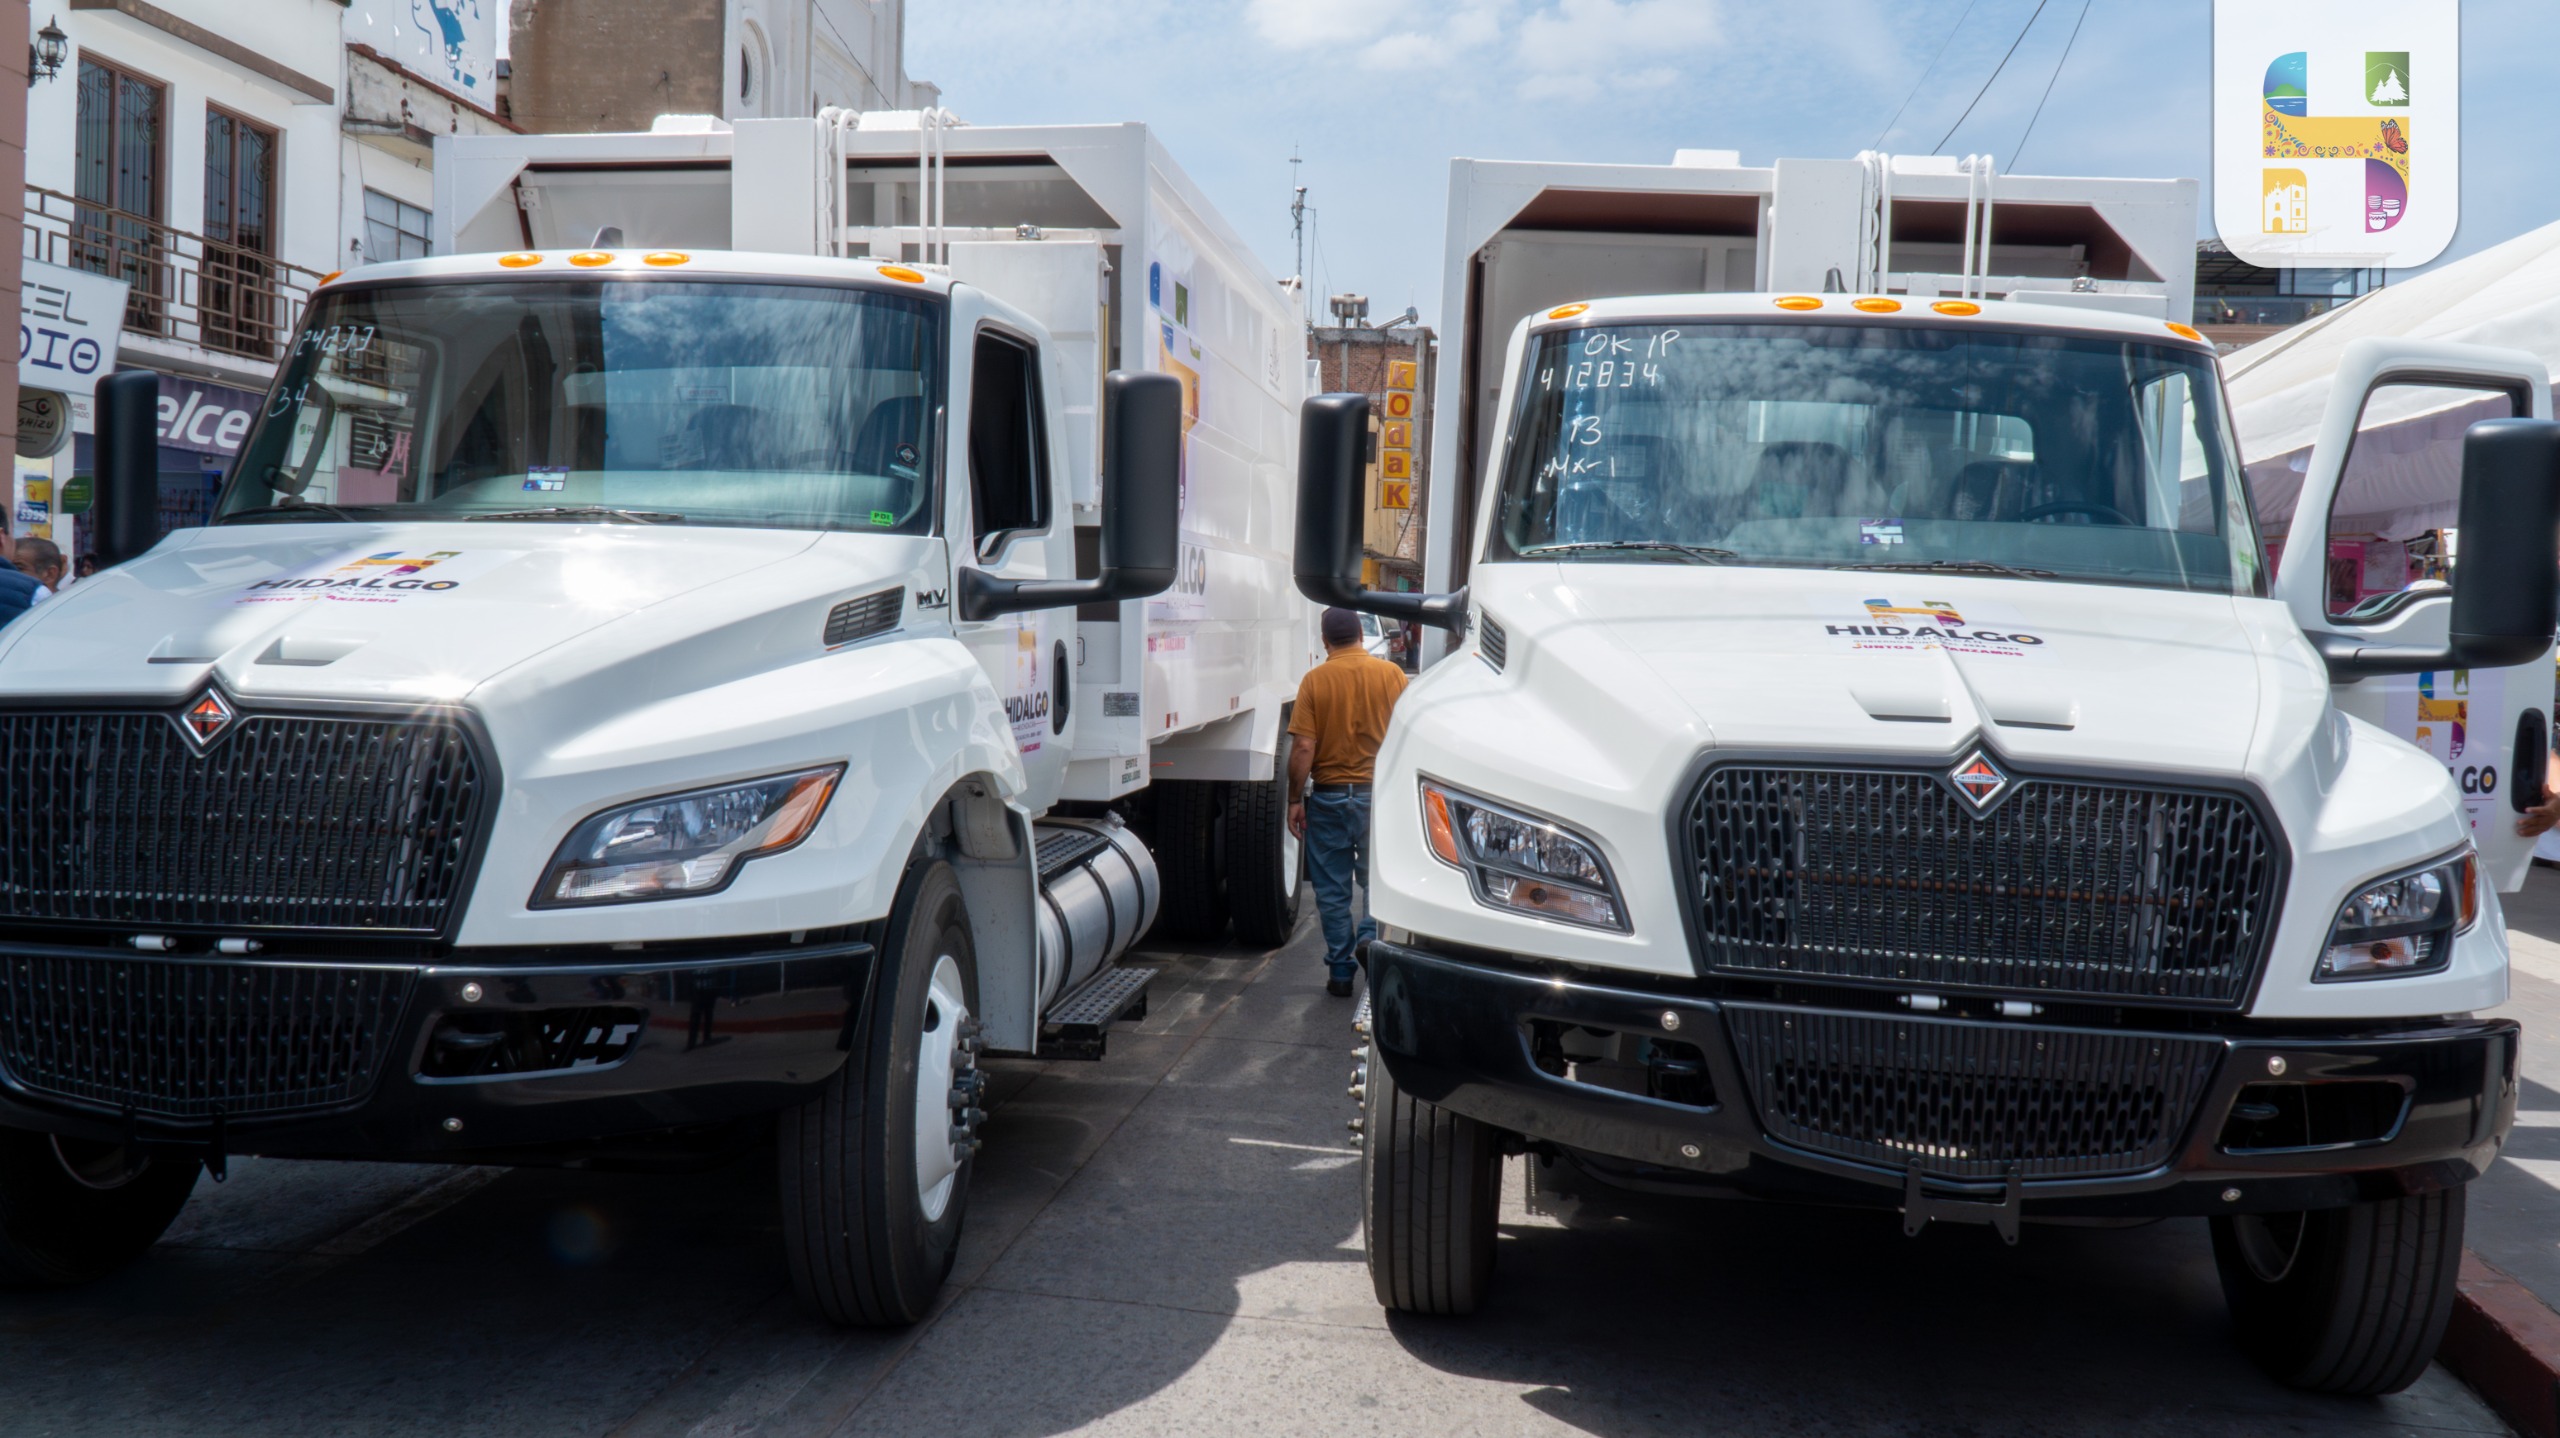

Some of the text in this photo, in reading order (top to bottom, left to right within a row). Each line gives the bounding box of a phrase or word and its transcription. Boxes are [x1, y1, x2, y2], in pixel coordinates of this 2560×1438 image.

[1584, 333, 1633, 356] OK
[246, 577, 460, 591] HIDALGO
[916, 589, 946, 606] MV
[1825, 624, 2045, 646] HIDALGO
[1005, 690, 1049, 723] HIDALGO
